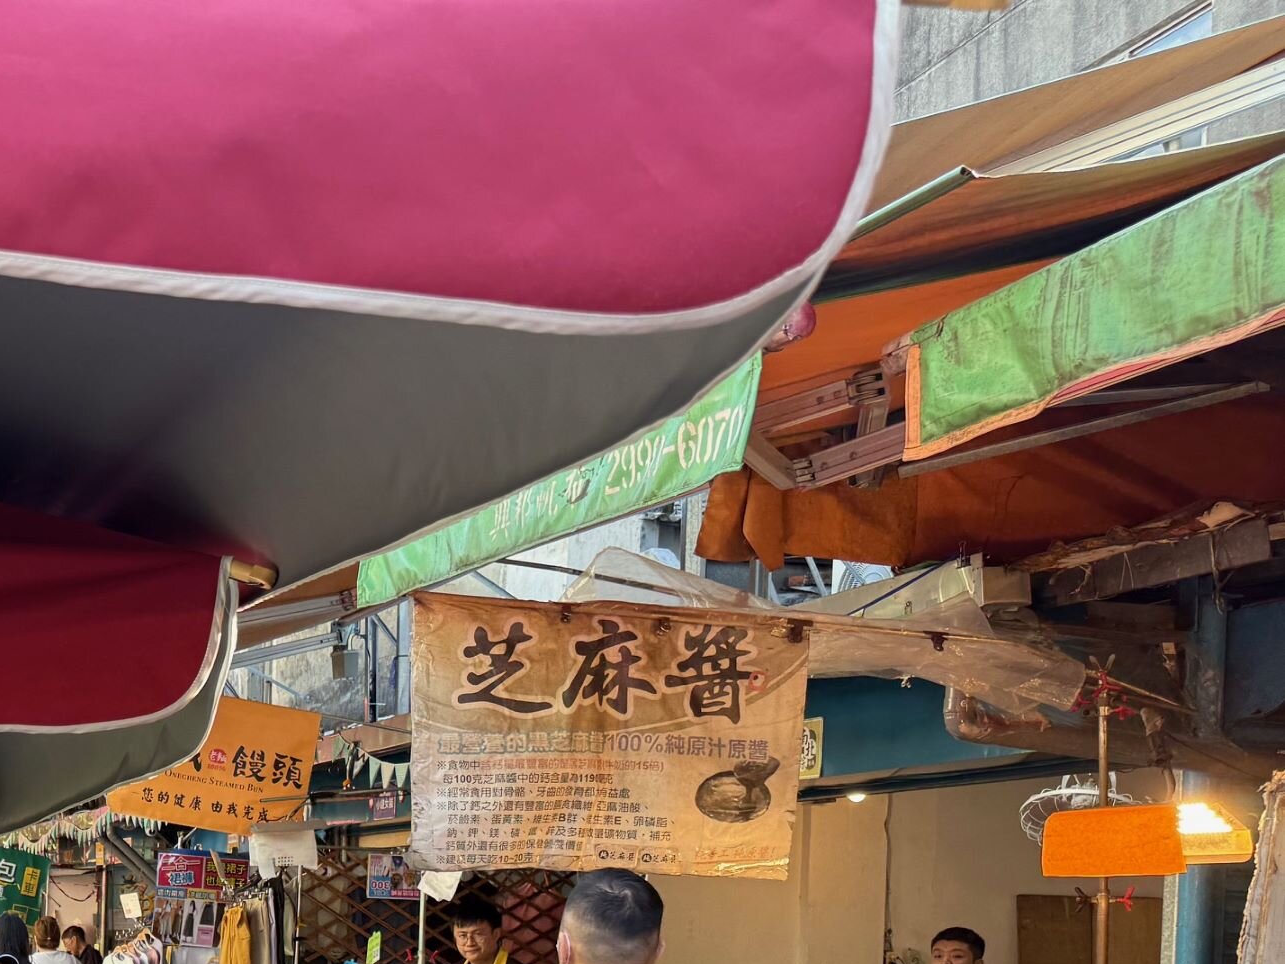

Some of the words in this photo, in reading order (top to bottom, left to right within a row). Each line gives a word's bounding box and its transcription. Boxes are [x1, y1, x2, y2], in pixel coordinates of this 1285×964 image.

[457, 619, 759, 724] 芝麻醬
[232, 745, 304, 790] 饅頭
[141, 787, 202, 811] 您的健康
[211, 801, 269, 824] 由我完成
[247, 783, 264, 794] BUN
[207, 859, 247, 875] 我裙子
